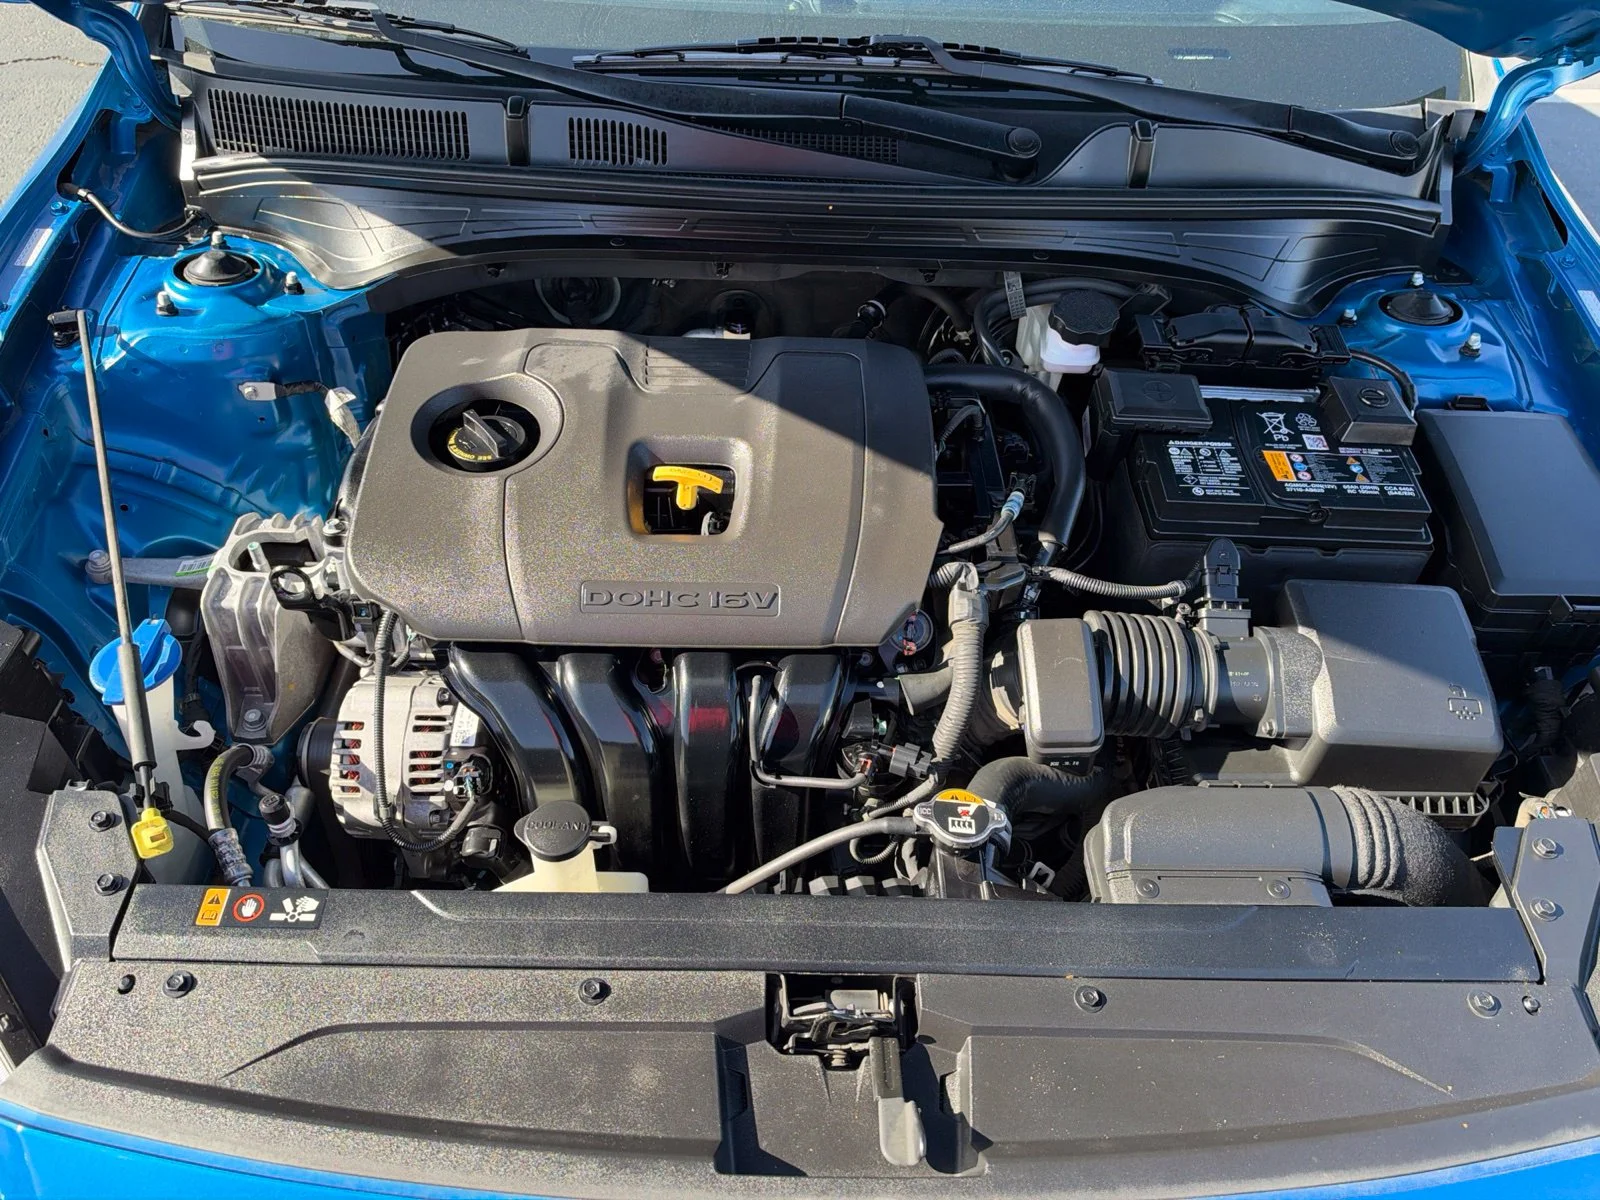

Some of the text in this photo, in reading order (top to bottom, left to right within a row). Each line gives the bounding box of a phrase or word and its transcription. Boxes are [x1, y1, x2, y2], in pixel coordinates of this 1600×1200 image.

[1273, 433, 1289, 441] Pb
[584, 588, 778, 609] DOHC 16V
[526, 820, 588, 832] COOLANT
